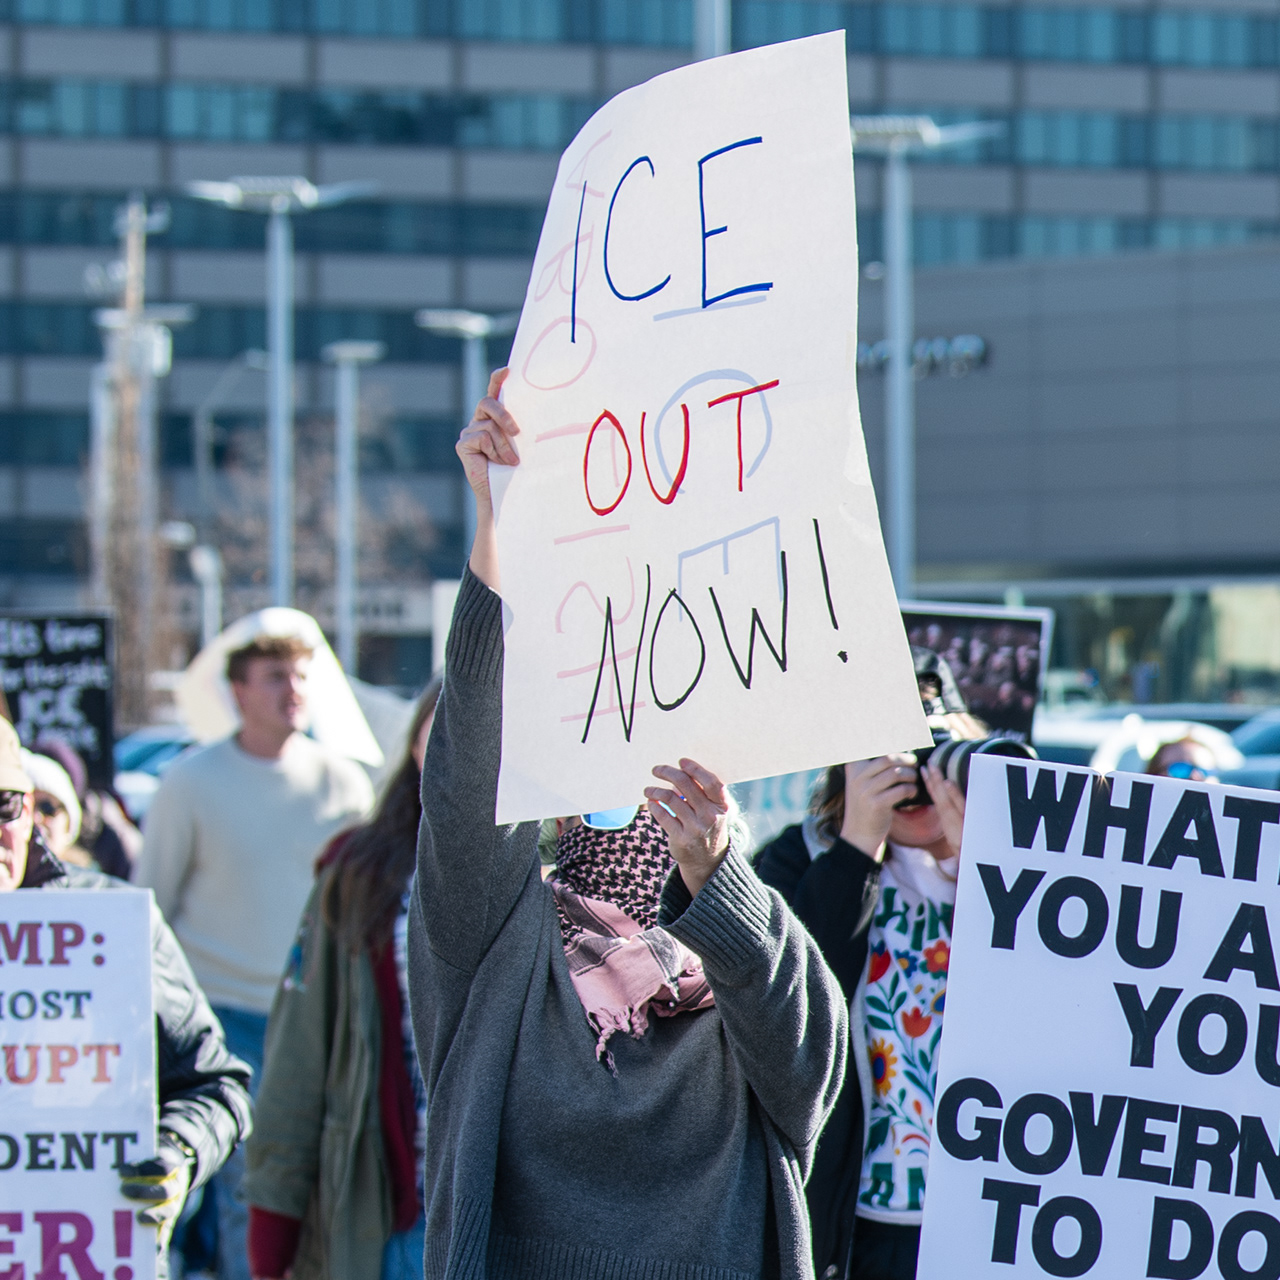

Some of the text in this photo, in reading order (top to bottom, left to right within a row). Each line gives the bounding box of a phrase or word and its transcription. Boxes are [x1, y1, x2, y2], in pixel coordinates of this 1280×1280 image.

[571, 136, 775, 345] ICE
[582, 378, 782, 518] OUT
[581, 517, 851, 744] NOW!
[976, 862, 1184, 970] YOU
[0, 990, 93, 1021] OST
[0, 1042, 122, 1085] UPT
[981, 1177, 1104, 1279] TO
